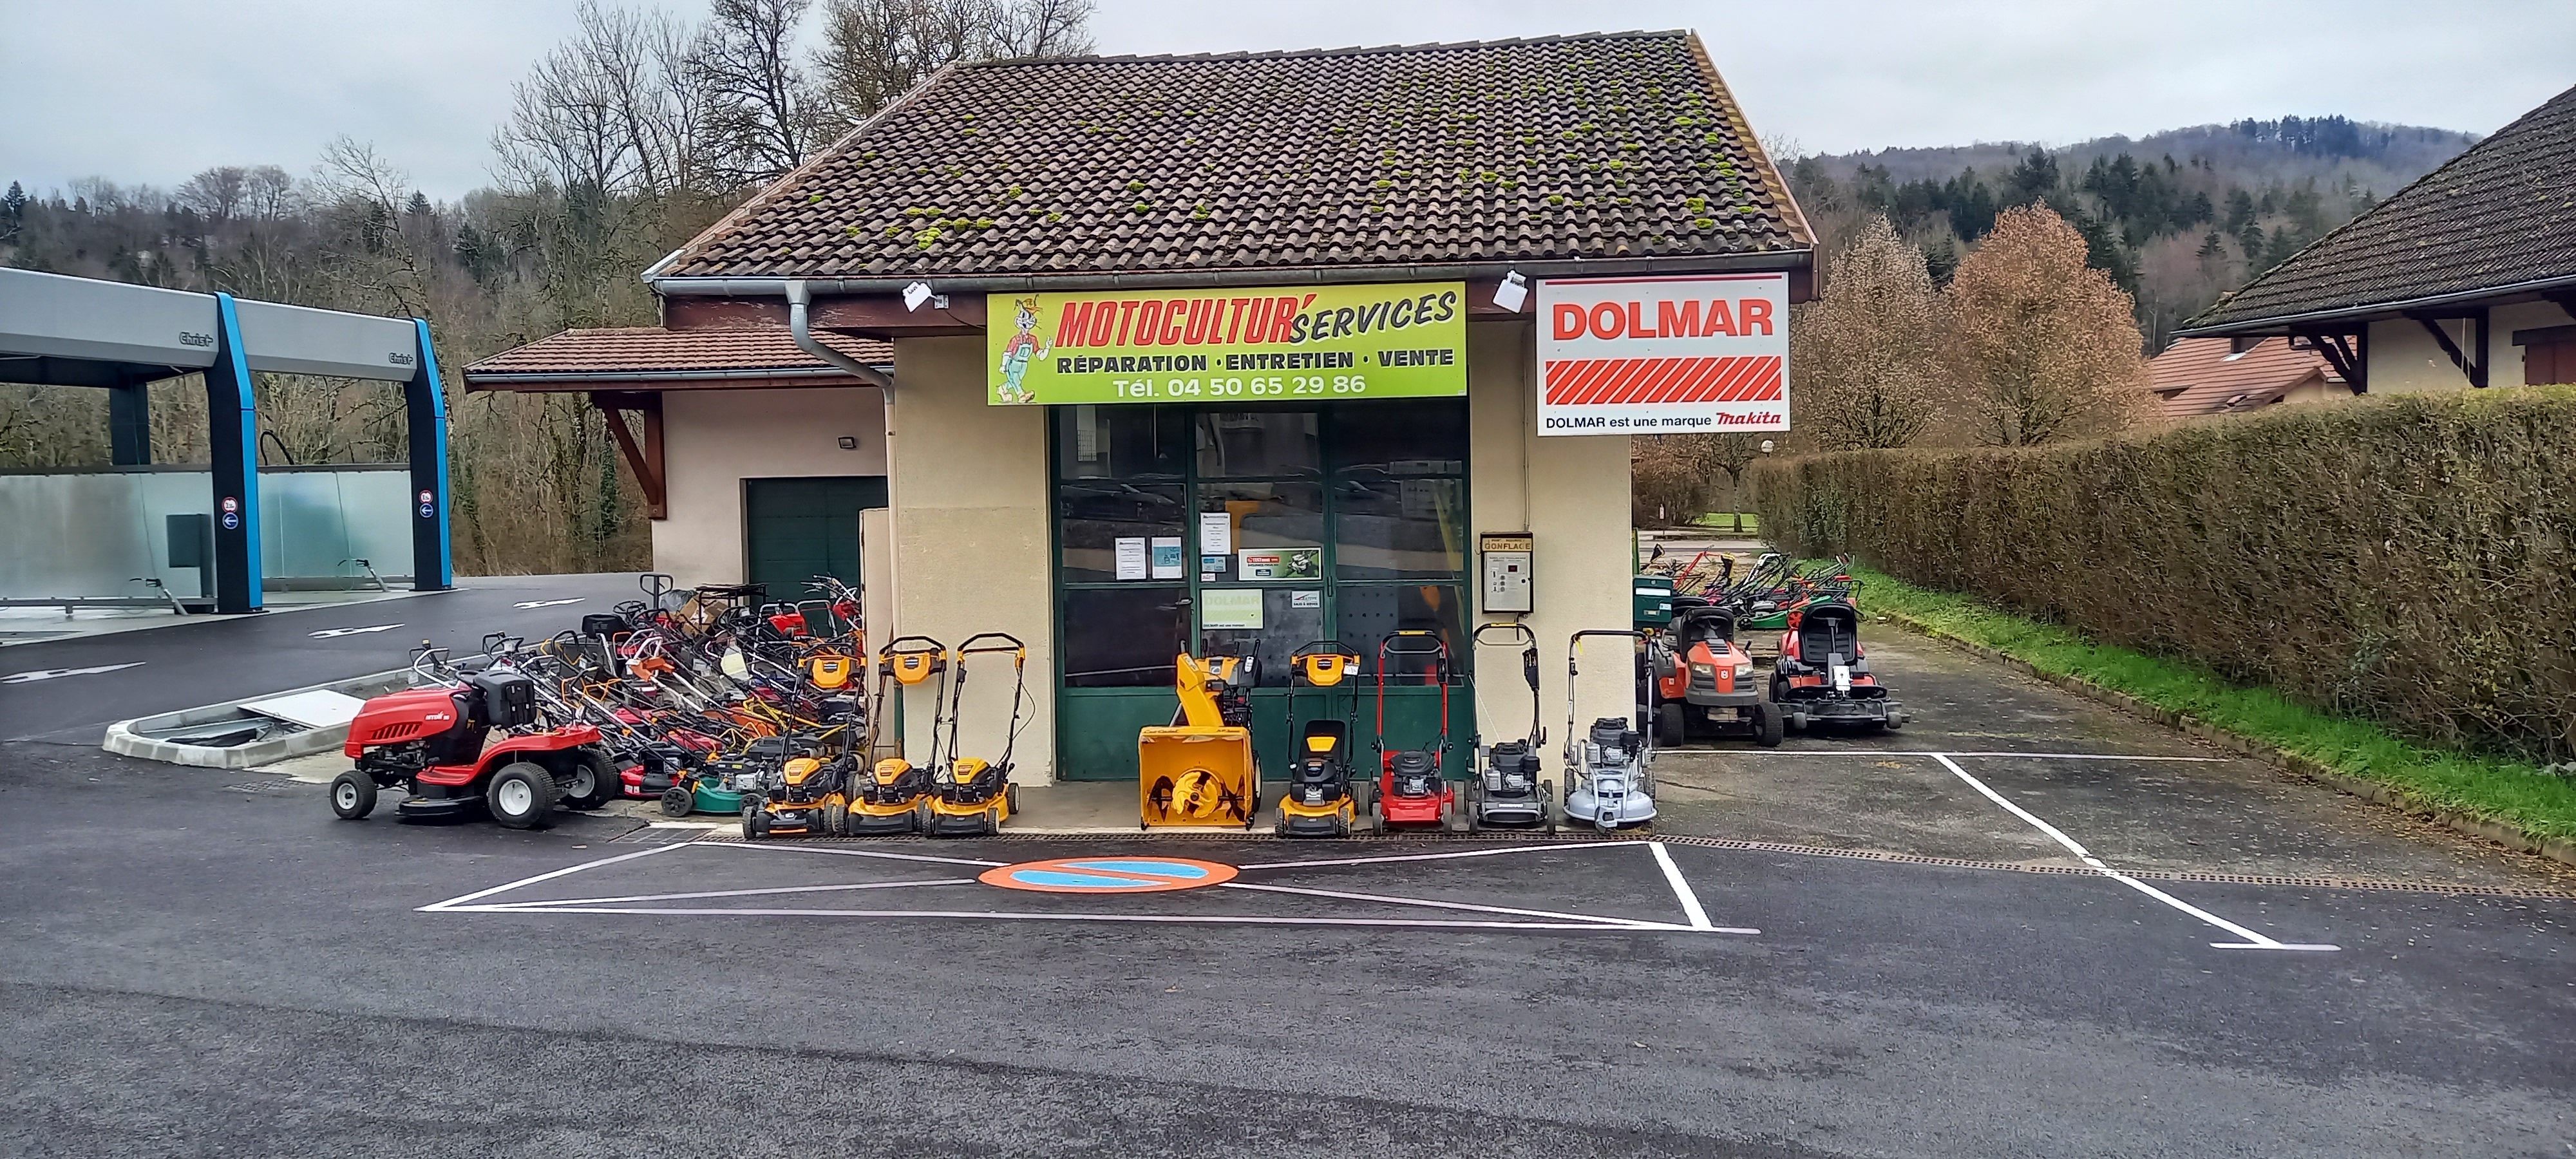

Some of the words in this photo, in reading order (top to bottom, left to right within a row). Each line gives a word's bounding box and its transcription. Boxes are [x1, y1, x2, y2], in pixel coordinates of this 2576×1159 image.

[1289, 290, 1457, 344] SERVICES
[1553, 299, 1774, 341] DOLMAR
[179, 332, 213, 346] Christ
[388, 352, 413, 364] Christ
[1057, 355, 1207, 373] RÉPARATION
[1226, 351, 1353, 371] ENTRETIEN
[1378, 349, 1454, 367] VENTE
[1112, 379, 1159, 397] Tél.
[1168, 378, 1201, 397] 04
[1209, 377, 1242, 396] 50
[1250, 377, 1283, 395] 65
[1292, 376, 1324, 394] 29
[1332, 375, 1366, 393] 86
[1546, 417, 1605, 429] DOLMAR
[1609, 417, 1629, 427] est
[1634, 418, 1658, 427] une
[1662, 417, 1712, 427] marque
